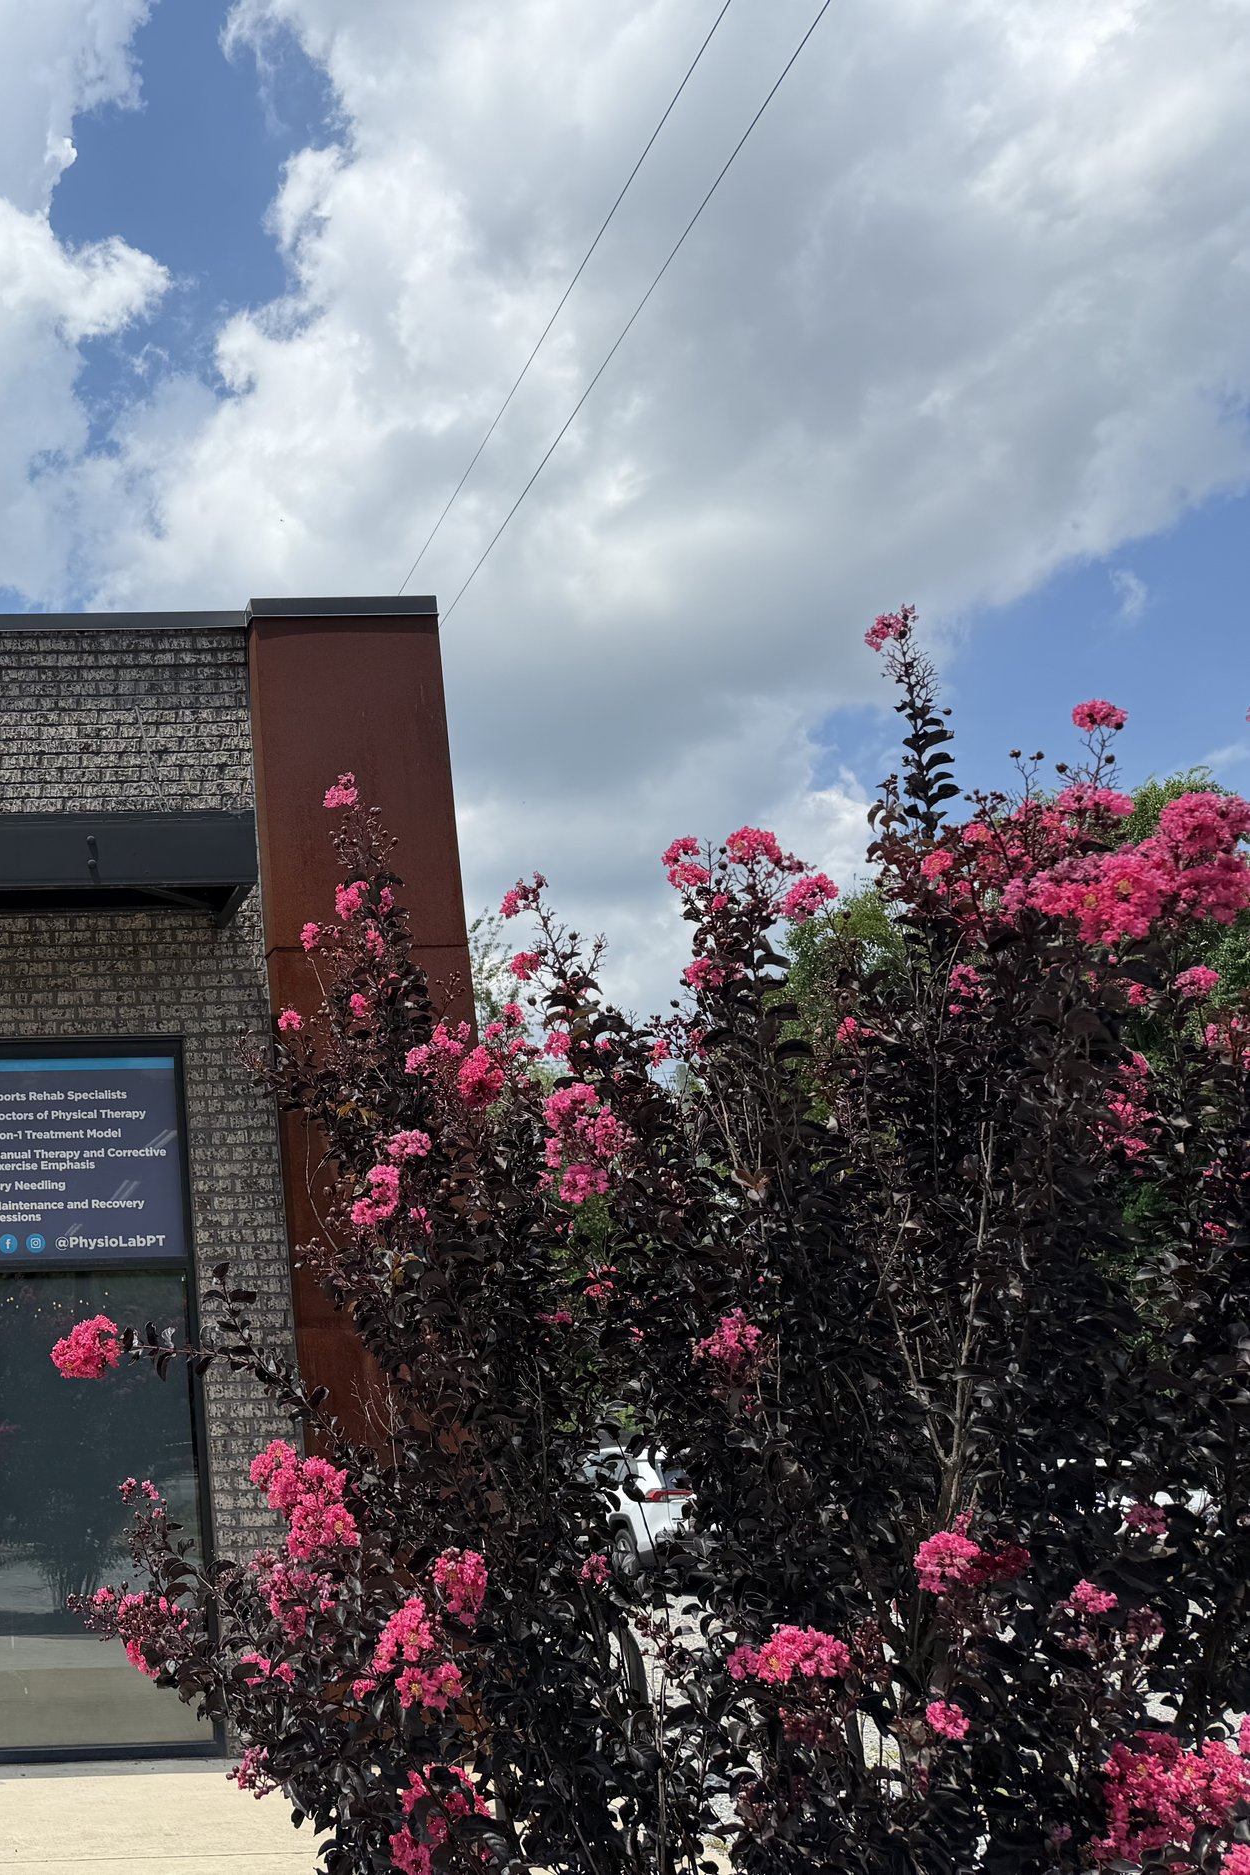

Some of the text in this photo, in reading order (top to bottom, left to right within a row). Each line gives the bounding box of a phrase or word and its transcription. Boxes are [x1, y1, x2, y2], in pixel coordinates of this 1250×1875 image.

[29, 1091, 65, 1101] Rehab
[67, 1089, 128, 1101] Specialists
[37, 1111, 49, 1119] of
[51, 1109, 97, 1121] Physical
[100, 1109, 146, 1120] Therapy
[25, 1130, 85, 1139] Treatment
[87, 1128, 122, 1138] Model
[34, 1149, 80, 1161] Therapy
[83, 1148, 105, 1158] and
[107, 1147, 167, 1158] Corrective
[41, 1160, 95, 1171] Emphasis
[14, 1180, 66, 1191] Needling
[67, 1199, 89, 1209] and
[91, 1199, 145, 1210] Recovery
[55, 1234, 166, 1251] @PhysioLabPT
